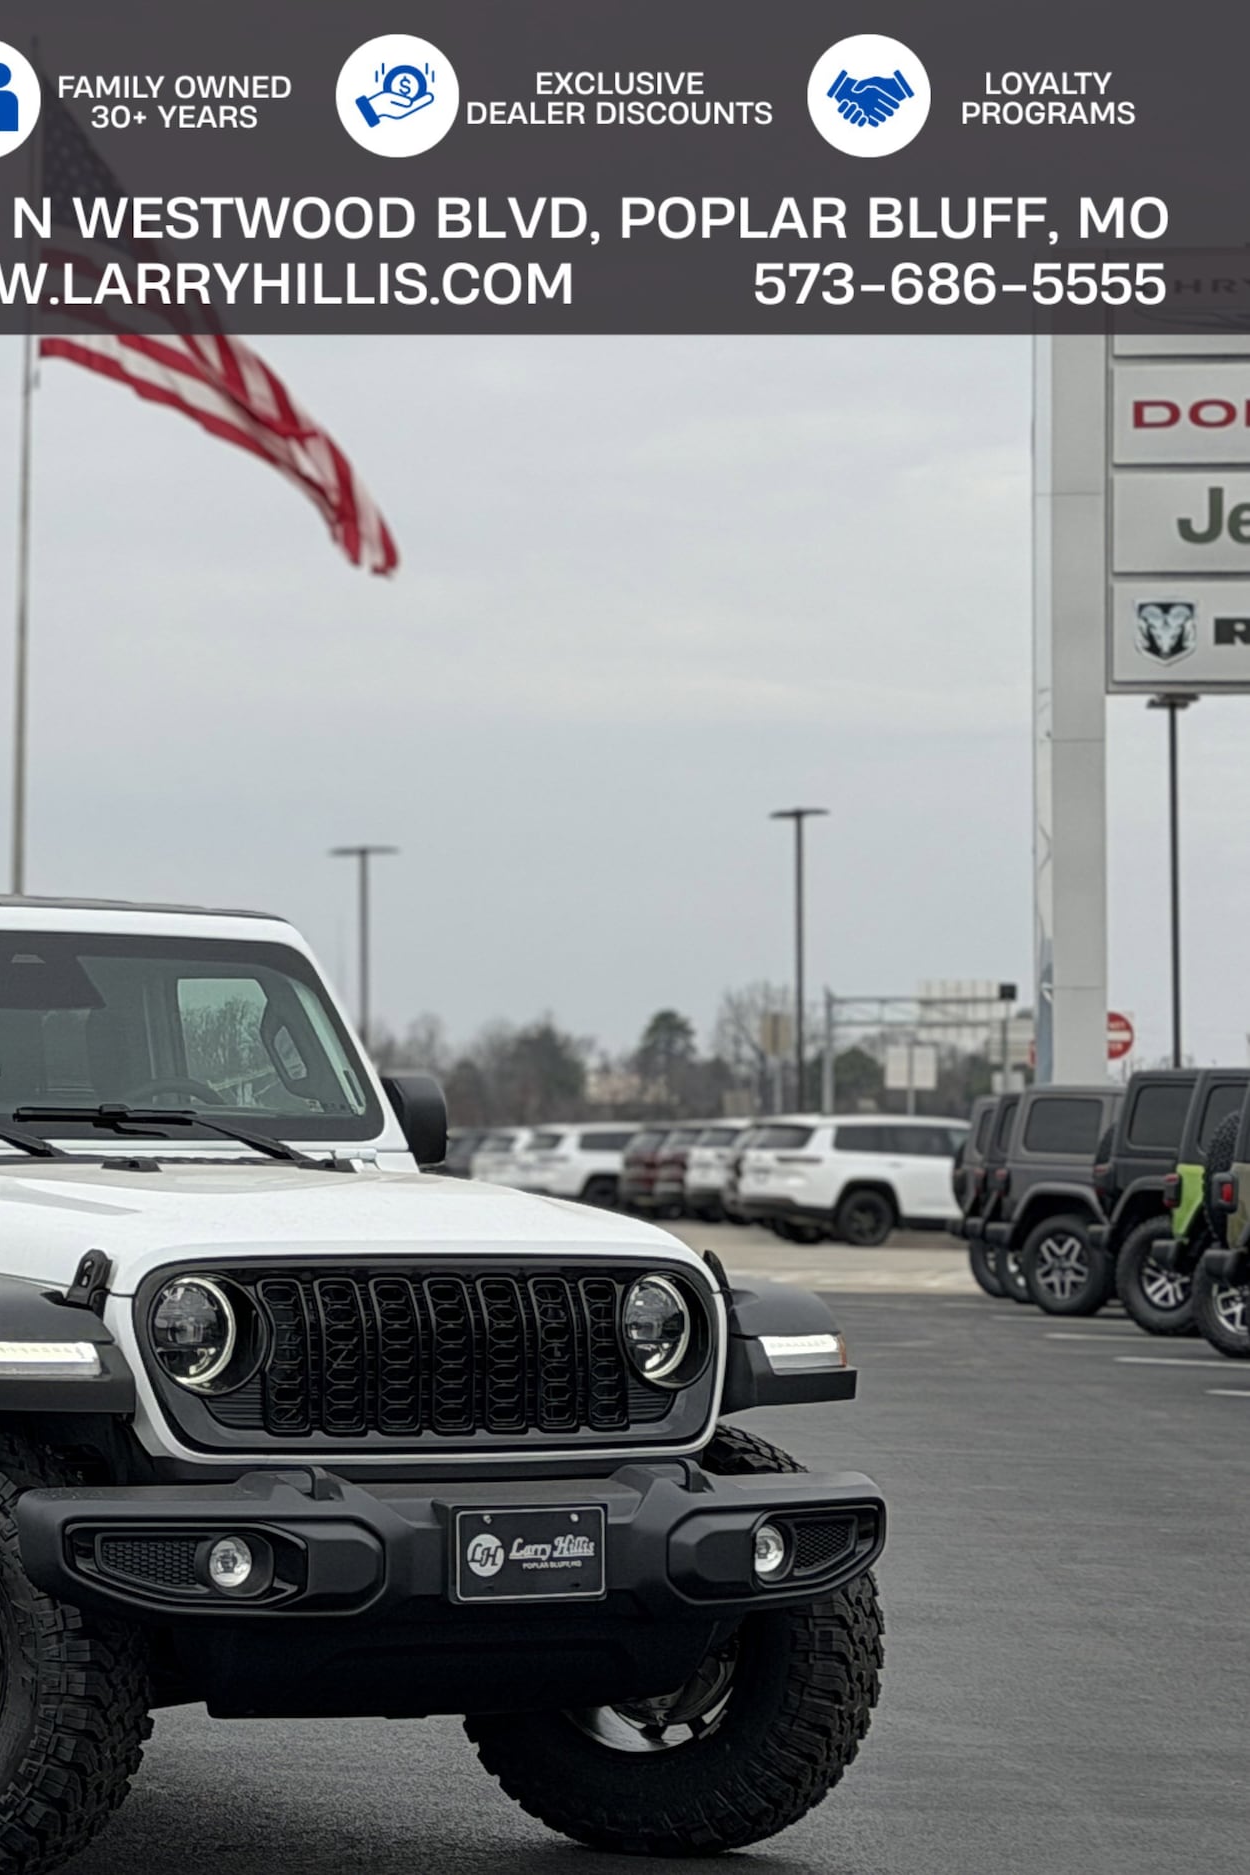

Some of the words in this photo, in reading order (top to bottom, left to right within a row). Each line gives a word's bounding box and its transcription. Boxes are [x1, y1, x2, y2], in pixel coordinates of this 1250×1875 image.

[1133, 399, 1250, 428] DO
[1177, 486, 1250, 545] Je
[1214, 617, 1250, 646] R
[469, 1543, 502, 1567] LH
[509, 1538, 551, 1560] Larry
[553, 1534, 595, 1556] Hillis
